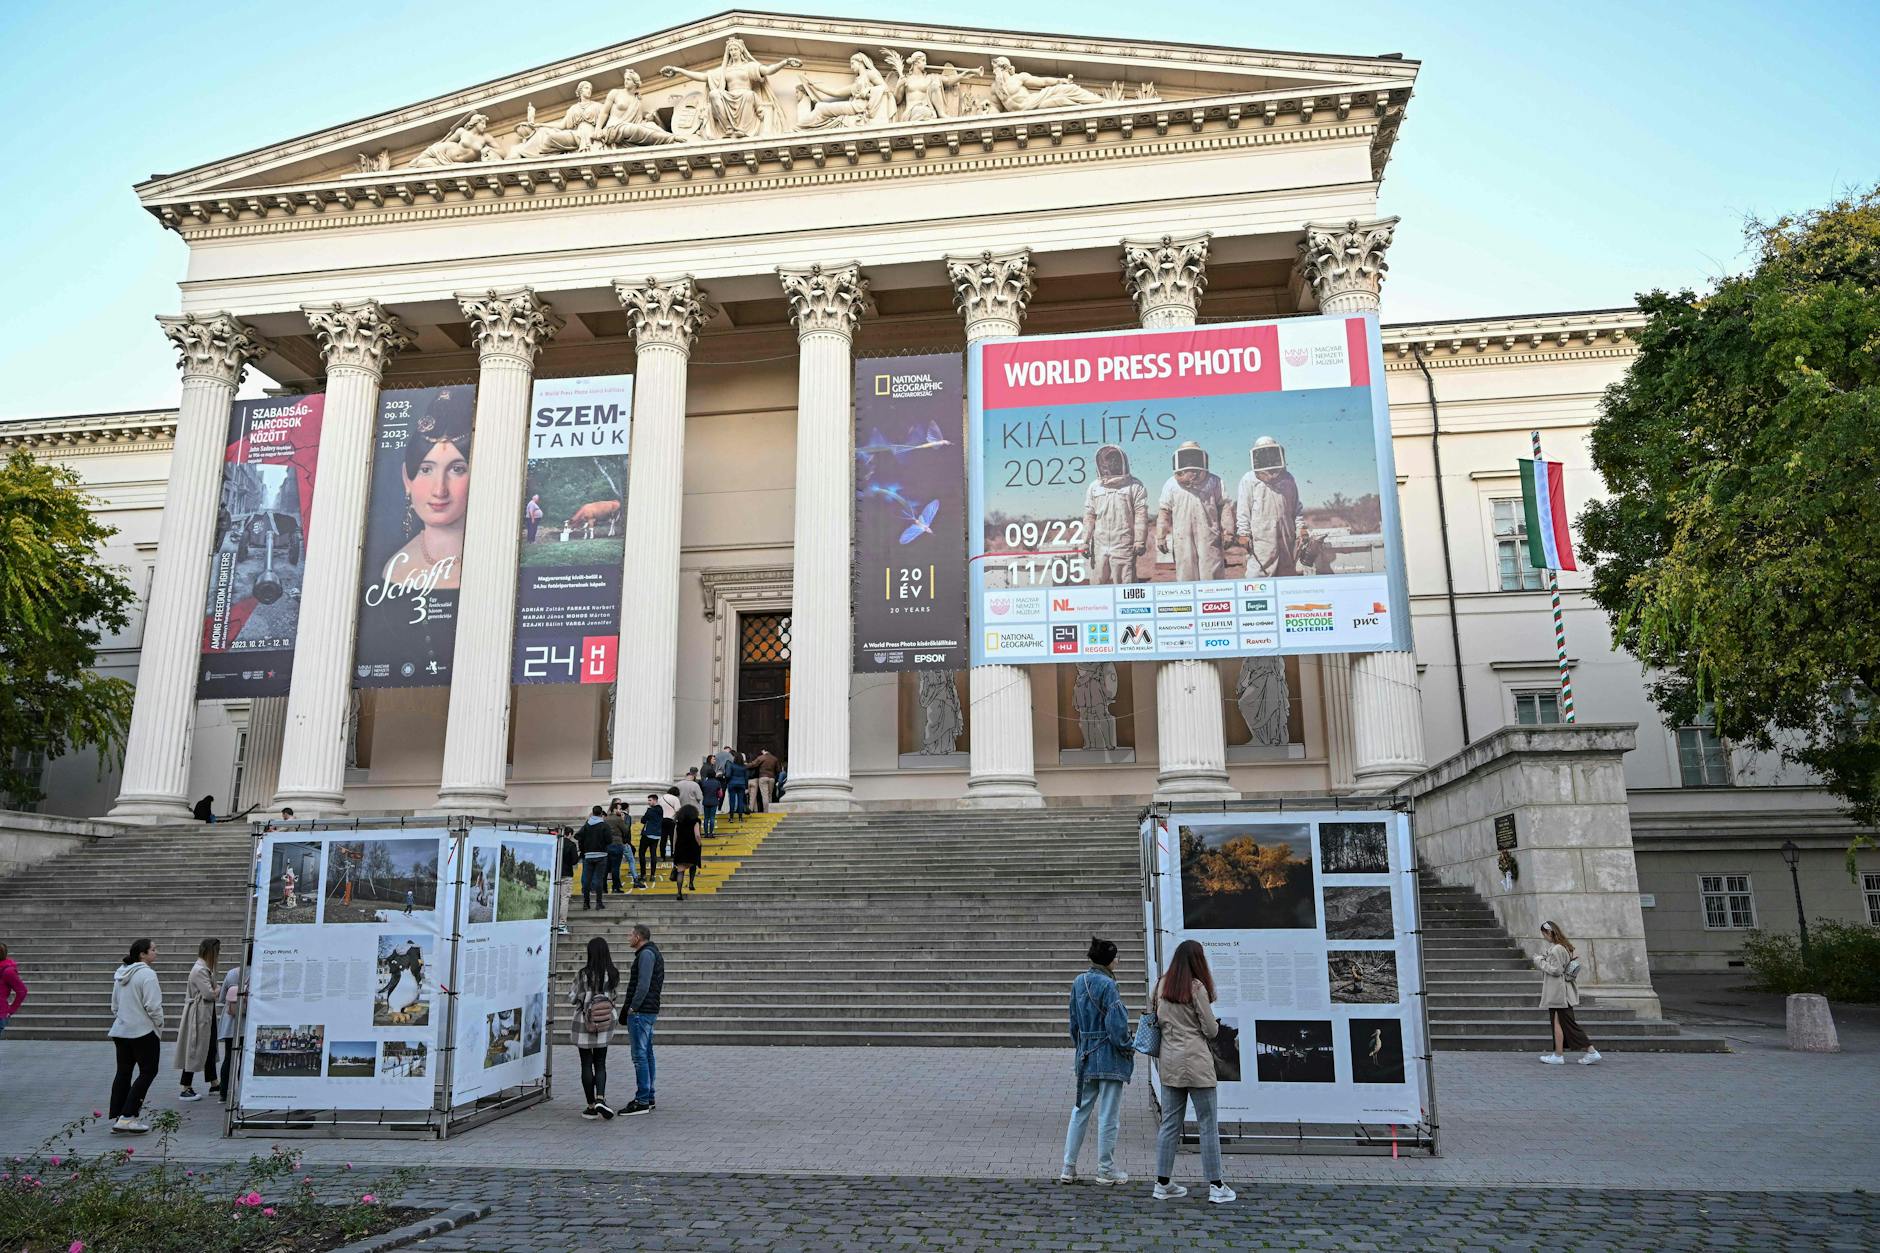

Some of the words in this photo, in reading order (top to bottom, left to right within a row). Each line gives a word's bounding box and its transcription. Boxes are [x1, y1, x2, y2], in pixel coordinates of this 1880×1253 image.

[1314, 345, 1342, 353] MAGYAR
[1315, 352, 1344, 360] NEMZETI
[1004, 358, 1091, 387] WORLD
[1098, 353, 1172, 381] PRESS
[1179, 347, 1262, 376] PHOTO
[892, 374, 932, 384] NATIONAL
[892, 382, 943, 393] GEOGRAPHIC
[252, 403, 313, 419] SZABADSÁG-
[385, 400, 413, 410] 2023.
[384, 412, 397, 420] 09.
[399, 410, 410, 418] 16.
[535, 404, 626, 428] SZEM-
[251, 417, 302, 430] HARCOSOK
[1003, 407, 1177, 449] KIÁLLÍTÁS
[249, 430, 287, 444] KÖZÖTT
[382, 430, 409, 440] 2023.
[534, 426, 625, 448] TANÚK
[381, 441, 392, 449] 12.
[394, 441, 407, 450] 31.
[1004, 456, 1086, 488] 2023
[1005, 520, 1084, 548] 09/22
[218, 552, 231, 587] FIGHTERS
[900, 568, 922, 581] 20
[1007, 558, 1086, 585] 11/05
[365, 552, 456, 607] Schöfft
[900, 583, 922, 598] ÉV
[214, 589, 226, 622] FREEDOM
[409, 596, 427, 624] 3
[1053, 599, 1075, 612] NL
[1201, 620, 1233, 628] FUJIFILM
[1285, 617, 1333, 628] POSTCODE
[1353, 617, 1379, 628] pwc
[211, 623, 222, 649] AMONG
[1001, 633, 1036, 641] NATIONAL
[1055, 628, 1075, 640] 24
[231, 641, 247, 649] 2023.
[1001, 641, 1044, 649] GEOGRAPHIC
[1205, 639, 1230, 647] FOTO
[914, 653, 945, 663] EPSON
